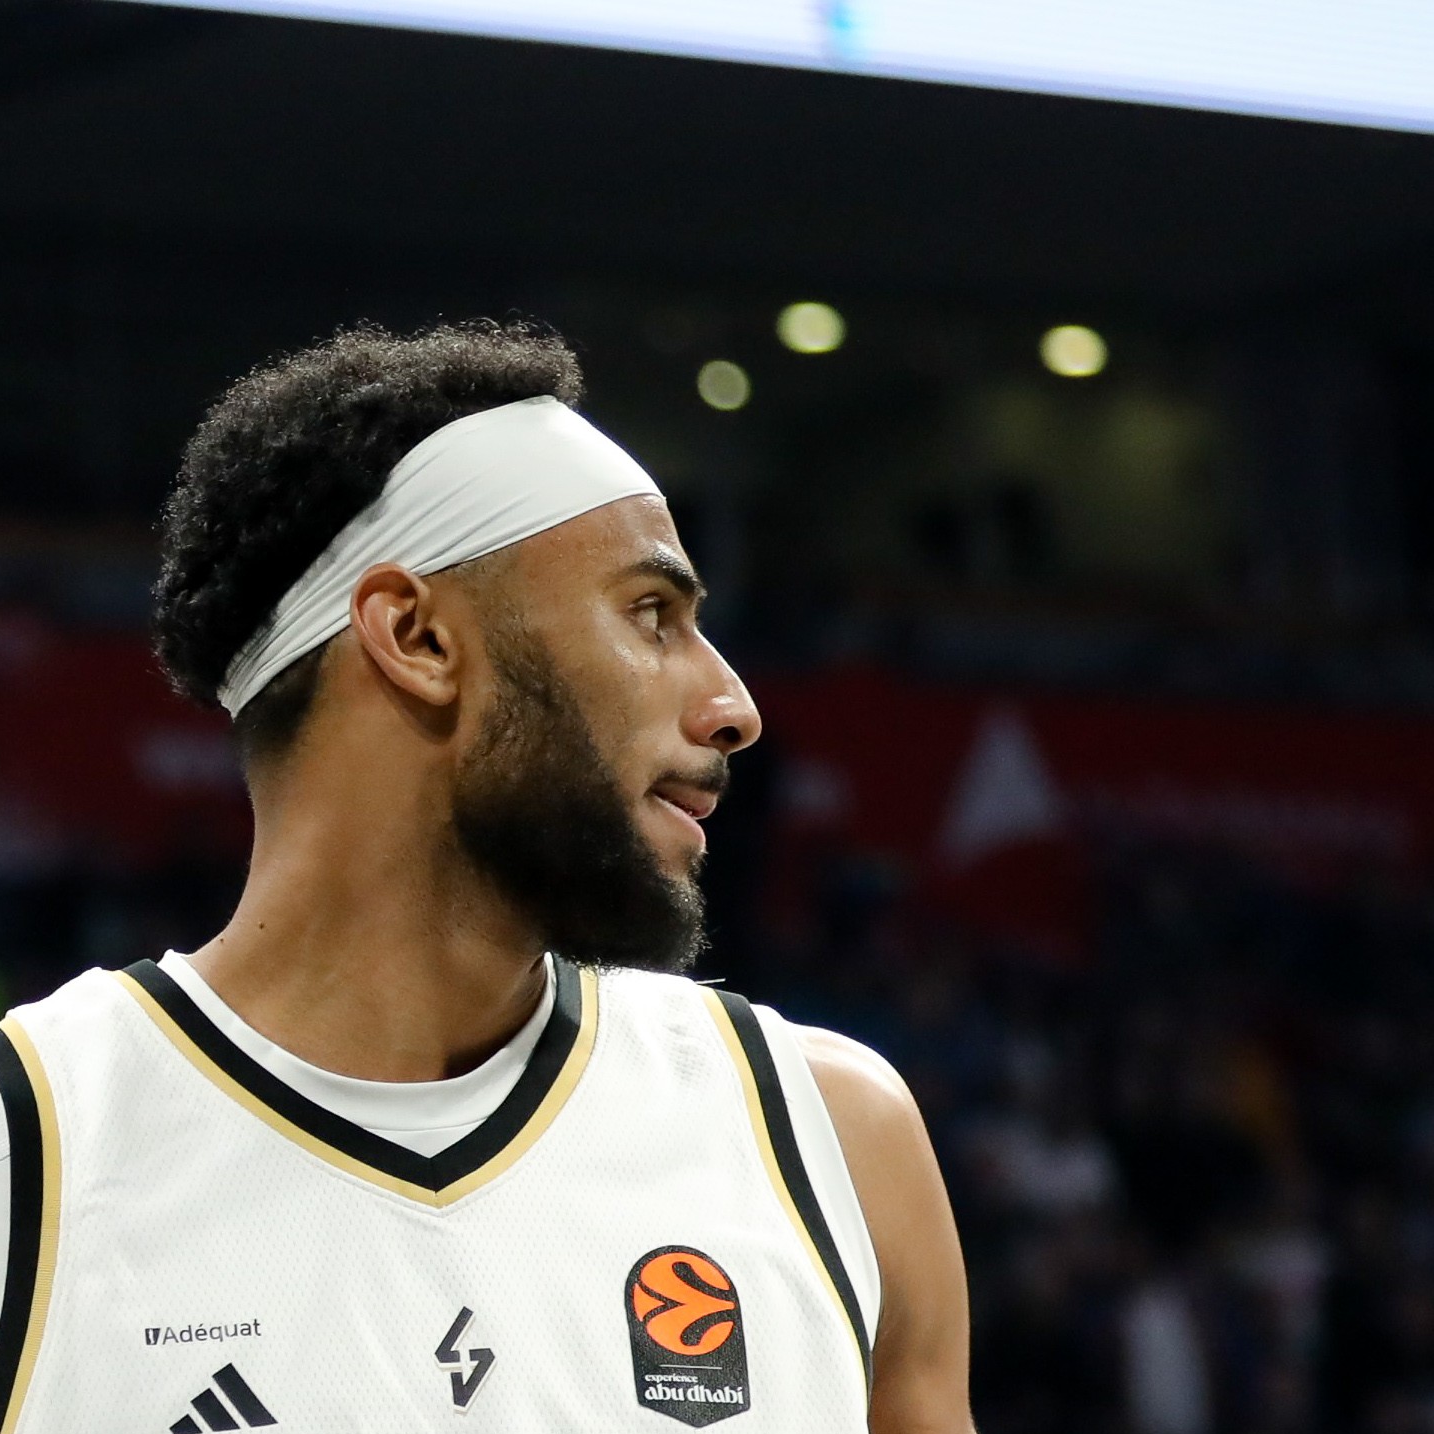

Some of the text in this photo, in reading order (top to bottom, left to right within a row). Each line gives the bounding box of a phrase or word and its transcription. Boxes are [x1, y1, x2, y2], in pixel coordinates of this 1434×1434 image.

[162, 1318, 261, 1345] Adéquat
[644, 1373, 698, 1383] experience
[644, 1383, 744, 1405] abu dhabi
